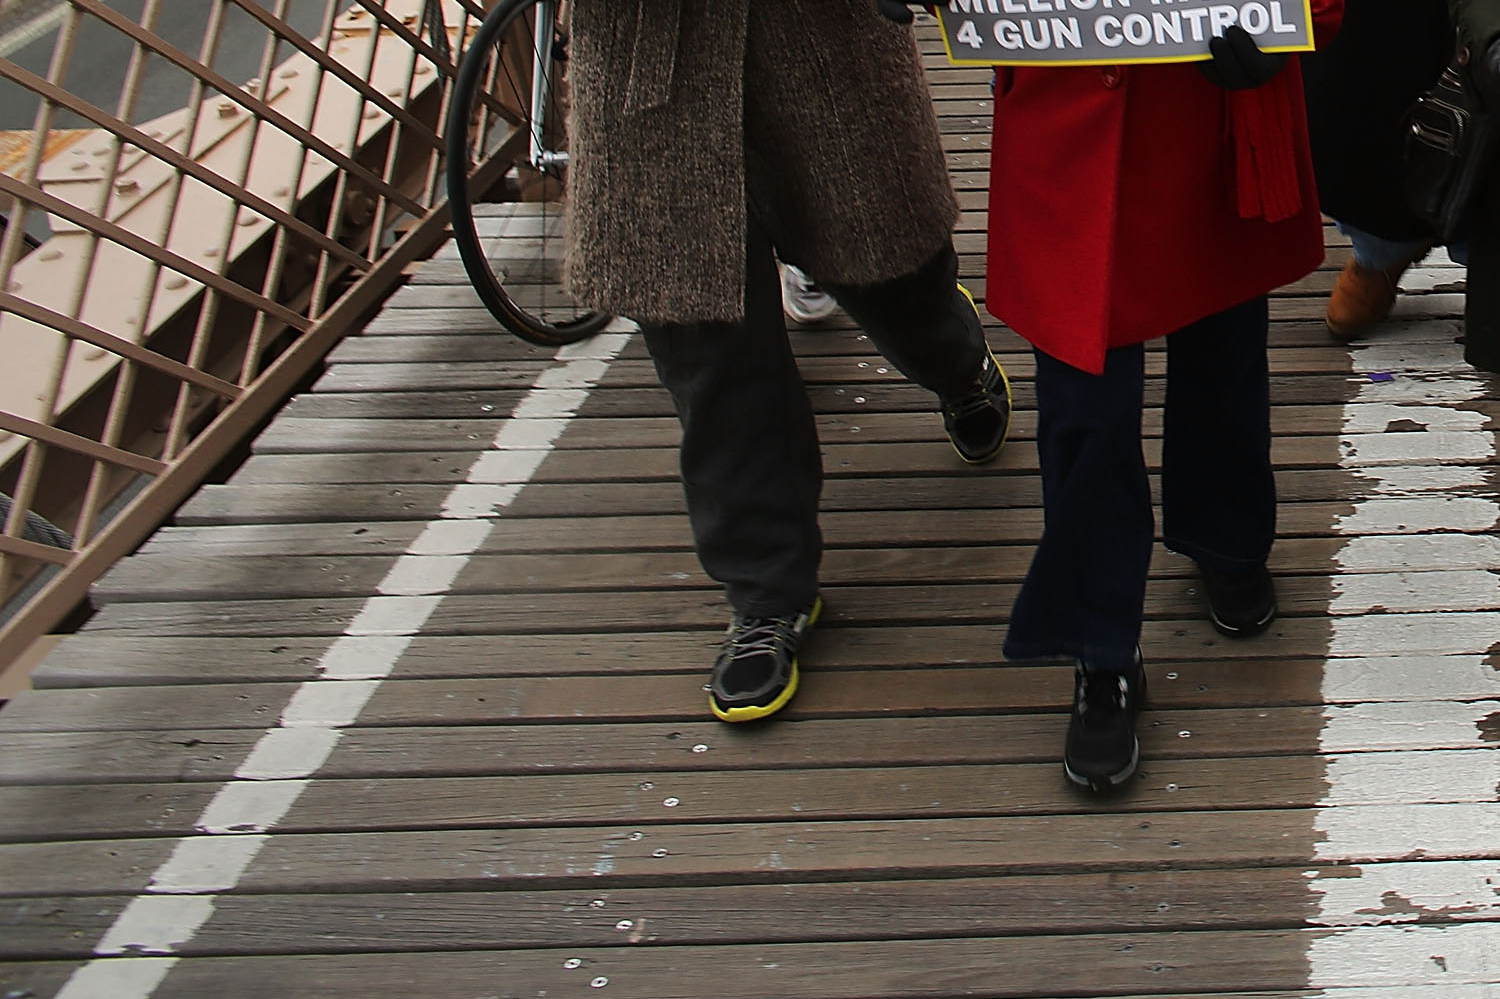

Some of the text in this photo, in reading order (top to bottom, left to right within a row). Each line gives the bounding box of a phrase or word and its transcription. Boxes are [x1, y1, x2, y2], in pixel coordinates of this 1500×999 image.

[956, 0, 1298, 51] 4 GUN CONTROL
